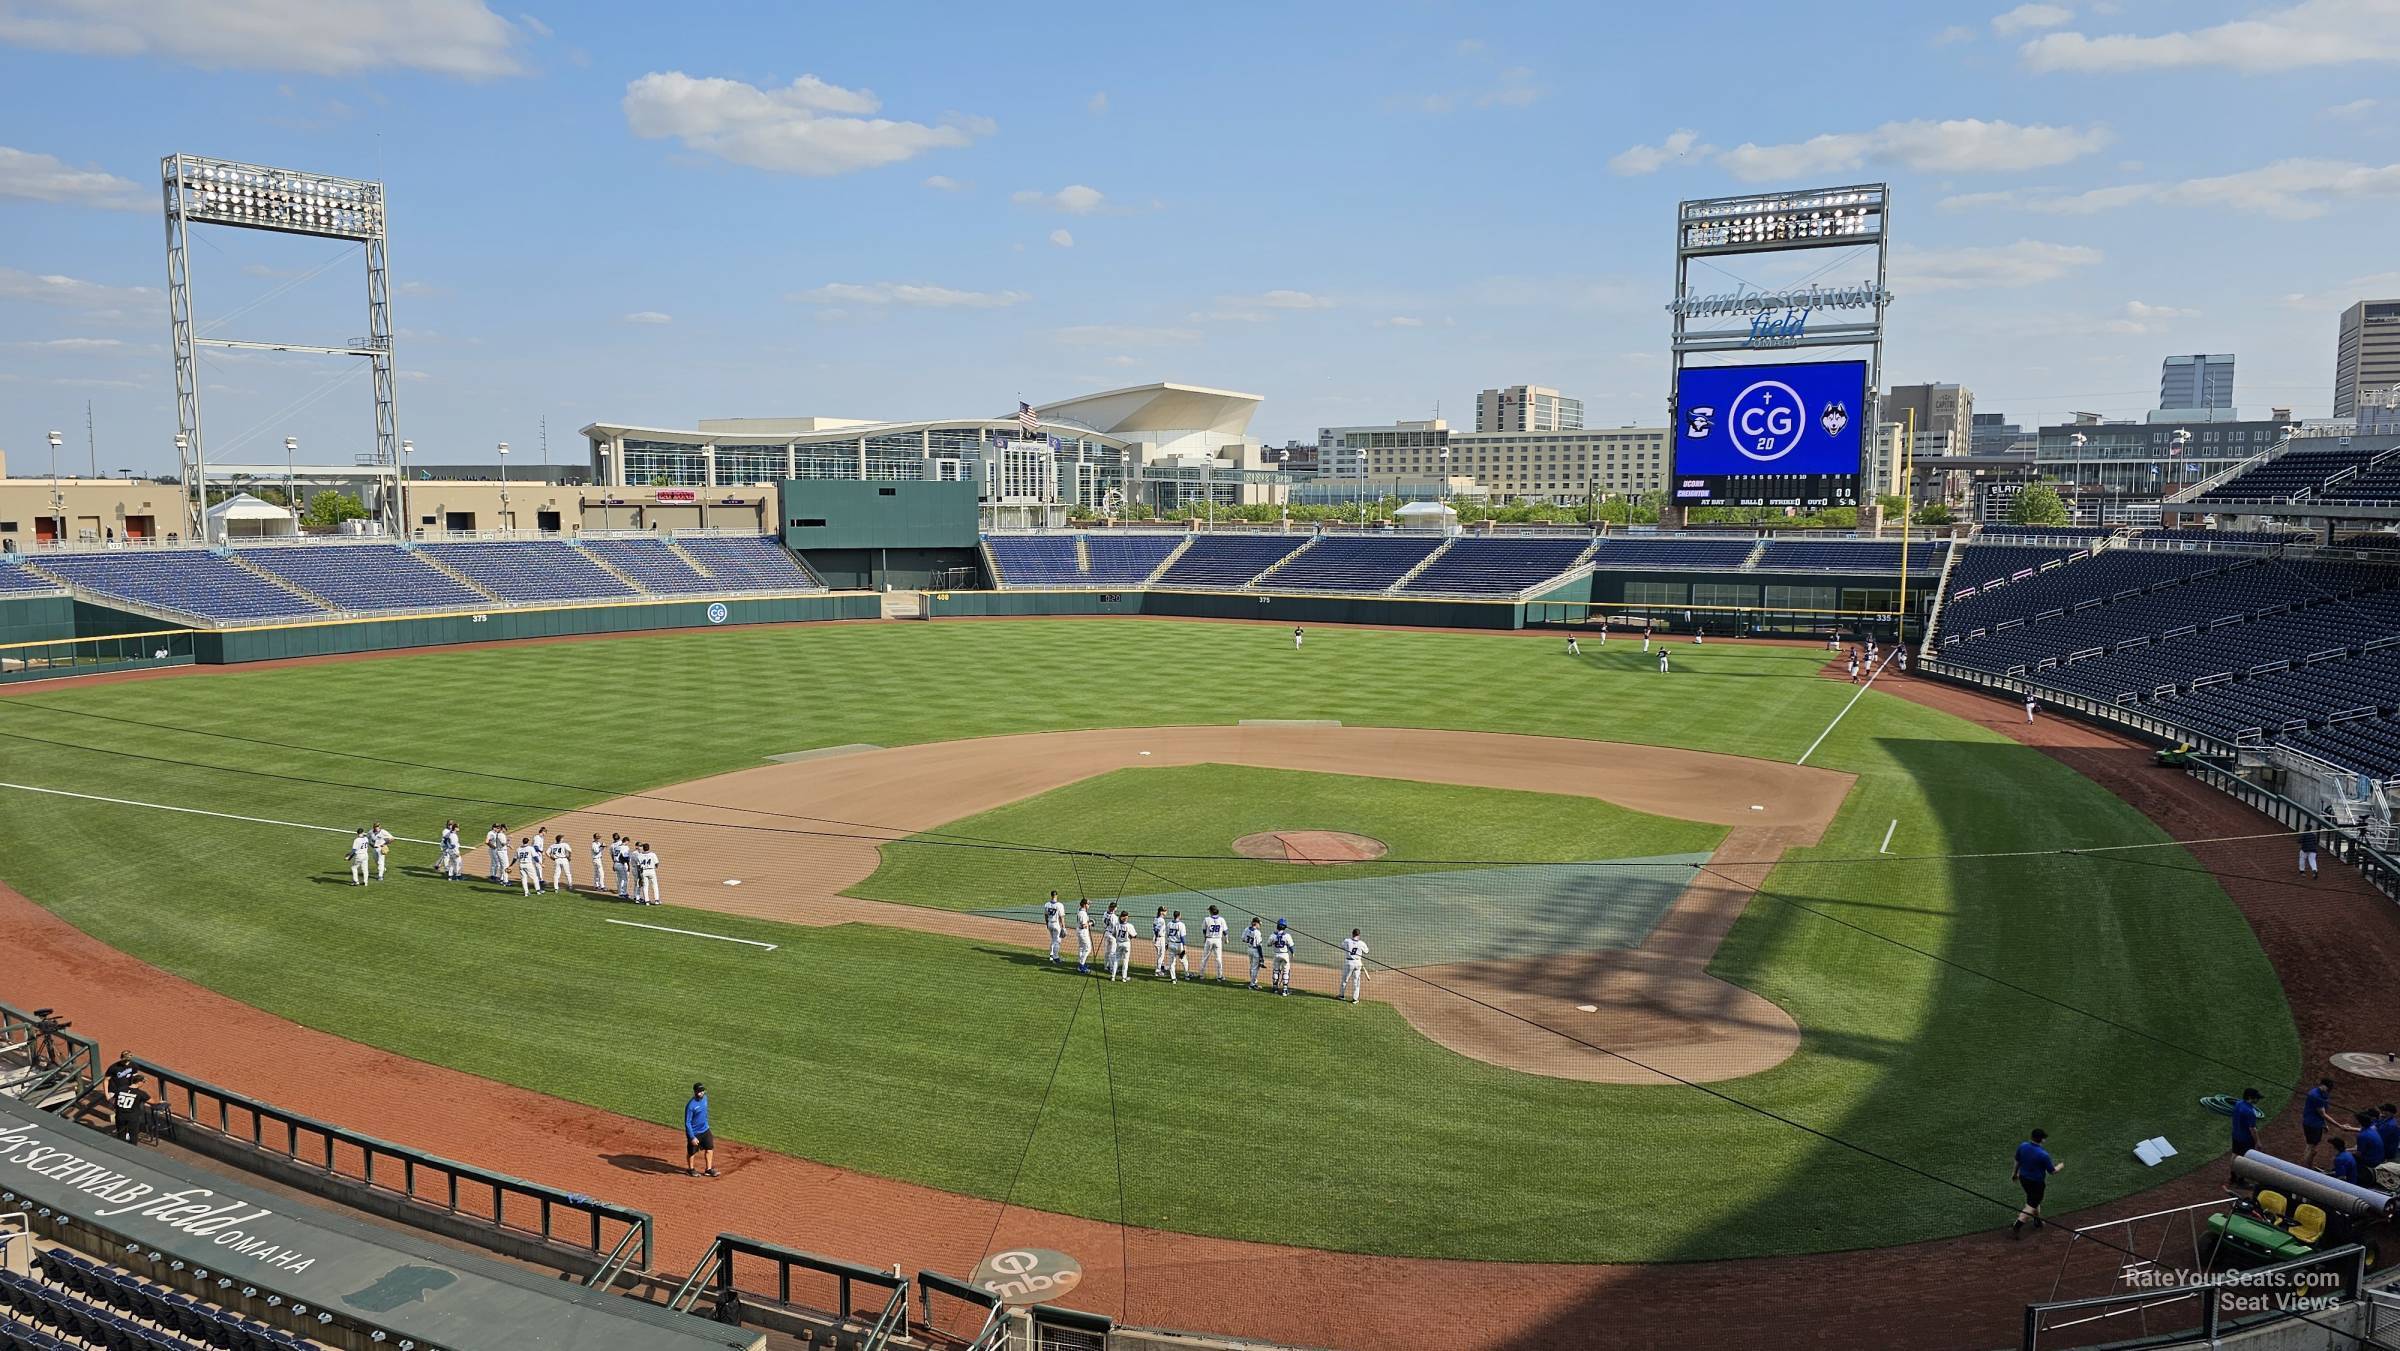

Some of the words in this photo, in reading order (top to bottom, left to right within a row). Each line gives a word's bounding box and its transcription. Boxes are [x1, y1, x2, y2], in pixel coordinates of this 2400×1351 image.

[1740, 308, 1810, 347] field
[1741, 407, 1792, 436] CG
[1756, 437, 1775, 450] 20
[1991, 485, 2023, 495] BLATT
[1259, 596, 1271, 604] 375
[710, 609, 724, 617] CG
[472, 614, 487, 623] 375
[1876, 614, 1892, 622] 335
[1168, 928, 1178, 937] 27
[1209, 924, 1221, 933] 38
[1118, 929, 1127, 938] 13
[117, 1095, 135, 1109] 20
[10, 1147, 154, 1204] SCHWAB
[95, 1189, 273, 1236] field
[214, 1230, 316, 1275] OMAHA
